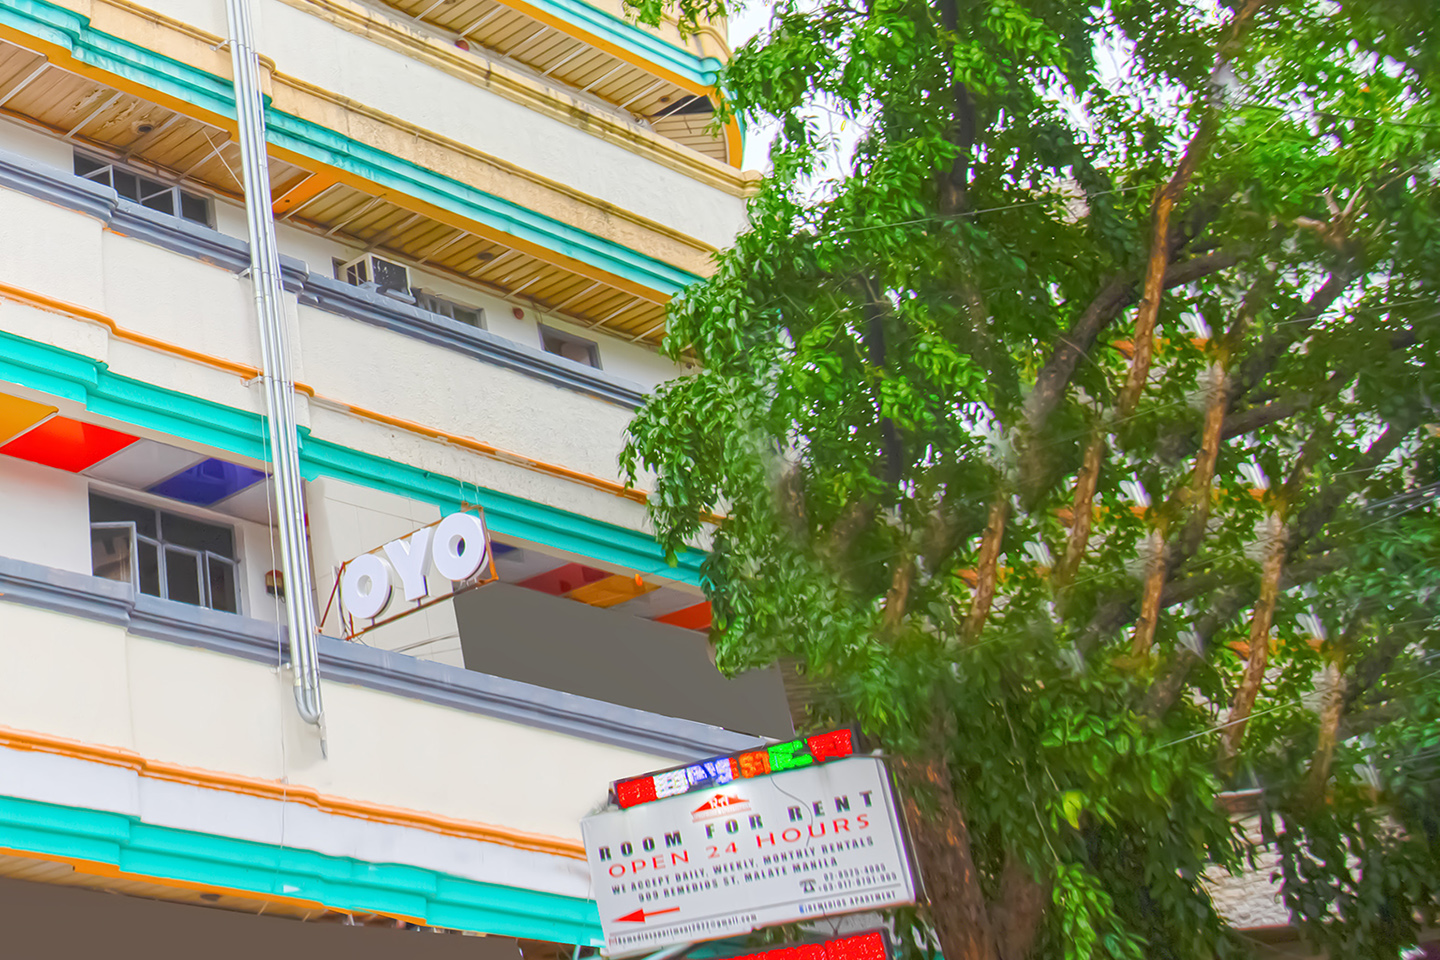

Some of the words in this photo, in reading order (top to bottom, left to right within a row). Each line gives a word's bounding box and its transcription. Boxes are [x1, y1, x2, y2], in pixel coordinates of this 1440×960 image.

[342, 512, 488, 619] OYO
[599, 829, 682, 862] ROOM
[705, 814, 763, 839] FOR
[787, 790, 872, 822] RENT
[608, 849, 689, 878] OPEN
[705, 842, 738, 859] 24
[756, 813, 870, 849] HOURS
[611, 883, 626, 895] WE
[631, 874, 670, 892] ACCEPT
[763, 846, 816, 866] MONTHLY
[821, 835, 874, 855] RENTALS
[663, 878, 719, 899] REMEDIOS
[744, 865, 788, 884] MALATE
[792, 855, 838, 874] MANILA
[849, 890, 896, 906] APARTMENT
